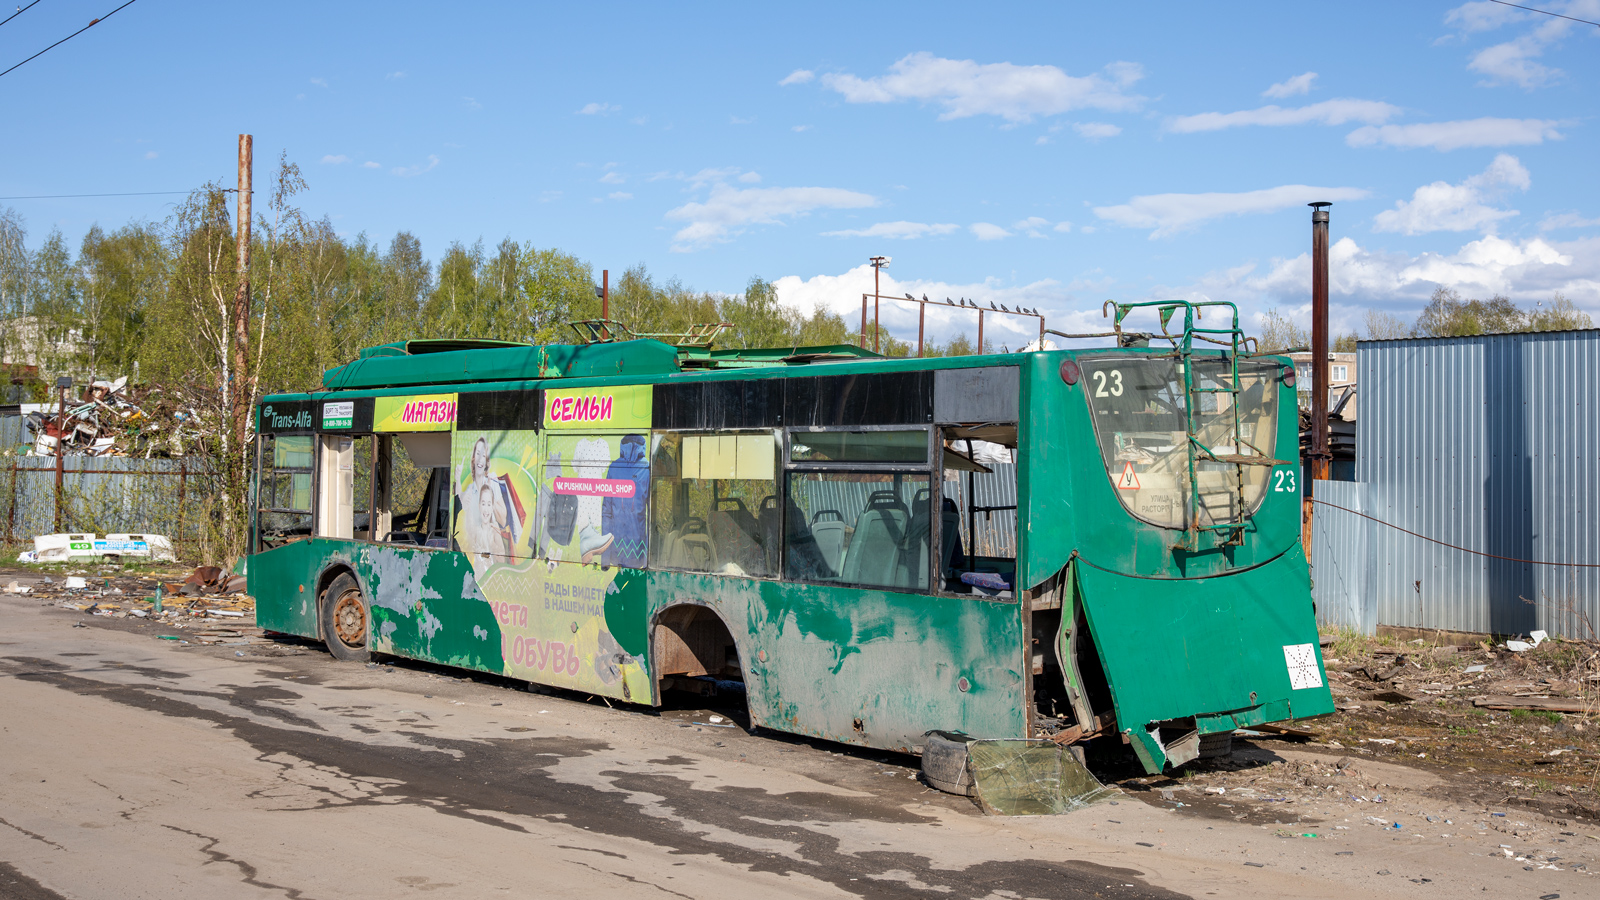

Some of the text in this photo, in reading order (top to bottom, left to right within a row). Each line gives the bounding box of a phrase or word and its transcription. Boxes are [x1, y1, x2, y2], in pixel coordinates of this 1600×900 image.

[1093, 370, 1123, 397] 23
[402, 401, 457, 424] МАГАЗИ
[551, 396, 613, 422] СЕМЬИ
[271, 411, 312, 428] Trans-Alfa
[564, 482, 633, 494] PUSHKINA_MODA_SHOP
[1275, 470, 1295, 492] 23
[360, 548, 370, 564] 23
[544, 582, 570, 598] РАДЫ
[544, 597, 550, 610] В
[552, 599, 585, 615] НАШЕМ
[513, 635, 580, 676] ОБУВЬ
